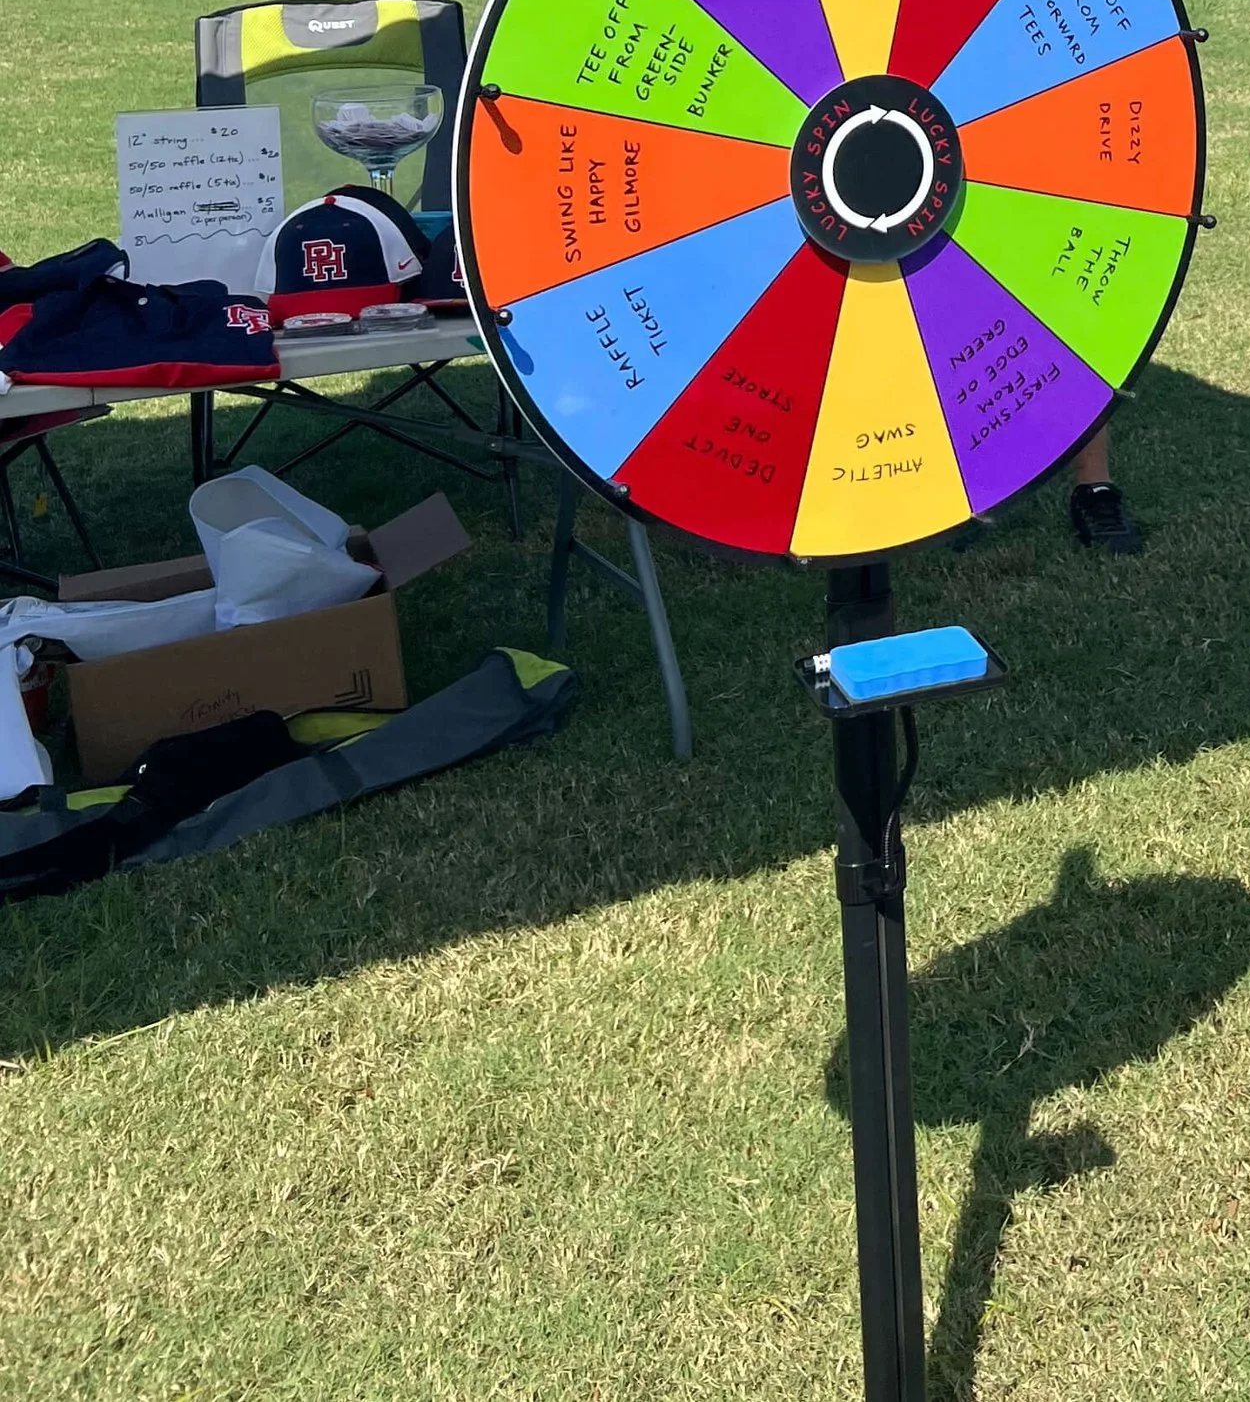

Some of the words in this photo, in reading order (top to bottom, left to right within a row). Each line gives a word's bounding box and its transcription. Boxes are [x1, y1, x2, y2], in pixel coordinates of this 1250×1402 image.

[607, 23, 649, 85] FROM
[1017, 5, 1052, 56] TEES
[576, 43, 607, 85] TEE
[635, 24, 676, 102] GREEN-
[665, 37, 694, 86] SIDE
[686, 43, 733, 118] BUNKER
[153, 136, 187, 149] string
[559, 124, 578, 174] LIKE
[807, 99, 851, 156] SPIN
[908, 98, 952, 165] LUCKY
[1099, 102, 1112, 162] DRIVE
[1127, 101, 1142, 165] DIZZY
[128, 160, 166, 175] 50/50
[173, 155, 205, 167] raffle
[129, 183, 164, 198] 50/50
[169, 178, 201, 191] raffle
[623, 139, 642, 234] GILMORE
[133, 208, 186, 223] Mulligan
[588, 158, 607, 225] HAPPY
[802, 171, 848, 241] LUCKY
[907, 180, 948, 236] SPIN
[557, 185, 582, 263] SWING
[302, 239, 347, 282] PH
[1052, 226, 1083, 277] BALL
[1076, 246, 1104, 292] THE
[1092, 236, 1131, 307] THROW
[623, 286, 668, 357] TICKET
[950, 318, 1006, 370] GREEN
[585, 305, 646, 390] RAFFLE
[985, 336, 1029, 383] EDGE
[722, 367, 793, 413] STROKE
[956, 378, 979, 405] OF
[976, 370, 1033, 414] FROM
[1012, 362, 1062, 411] FIRST
[724, 416, 771, 443] ONE
[855, 423, 916, 449] SWAG
[967, 406, 1013, 452] SHOT
[684, 434, 776, 484] DEDUCT
[832, 457, 922, 483] ATHLETIC
